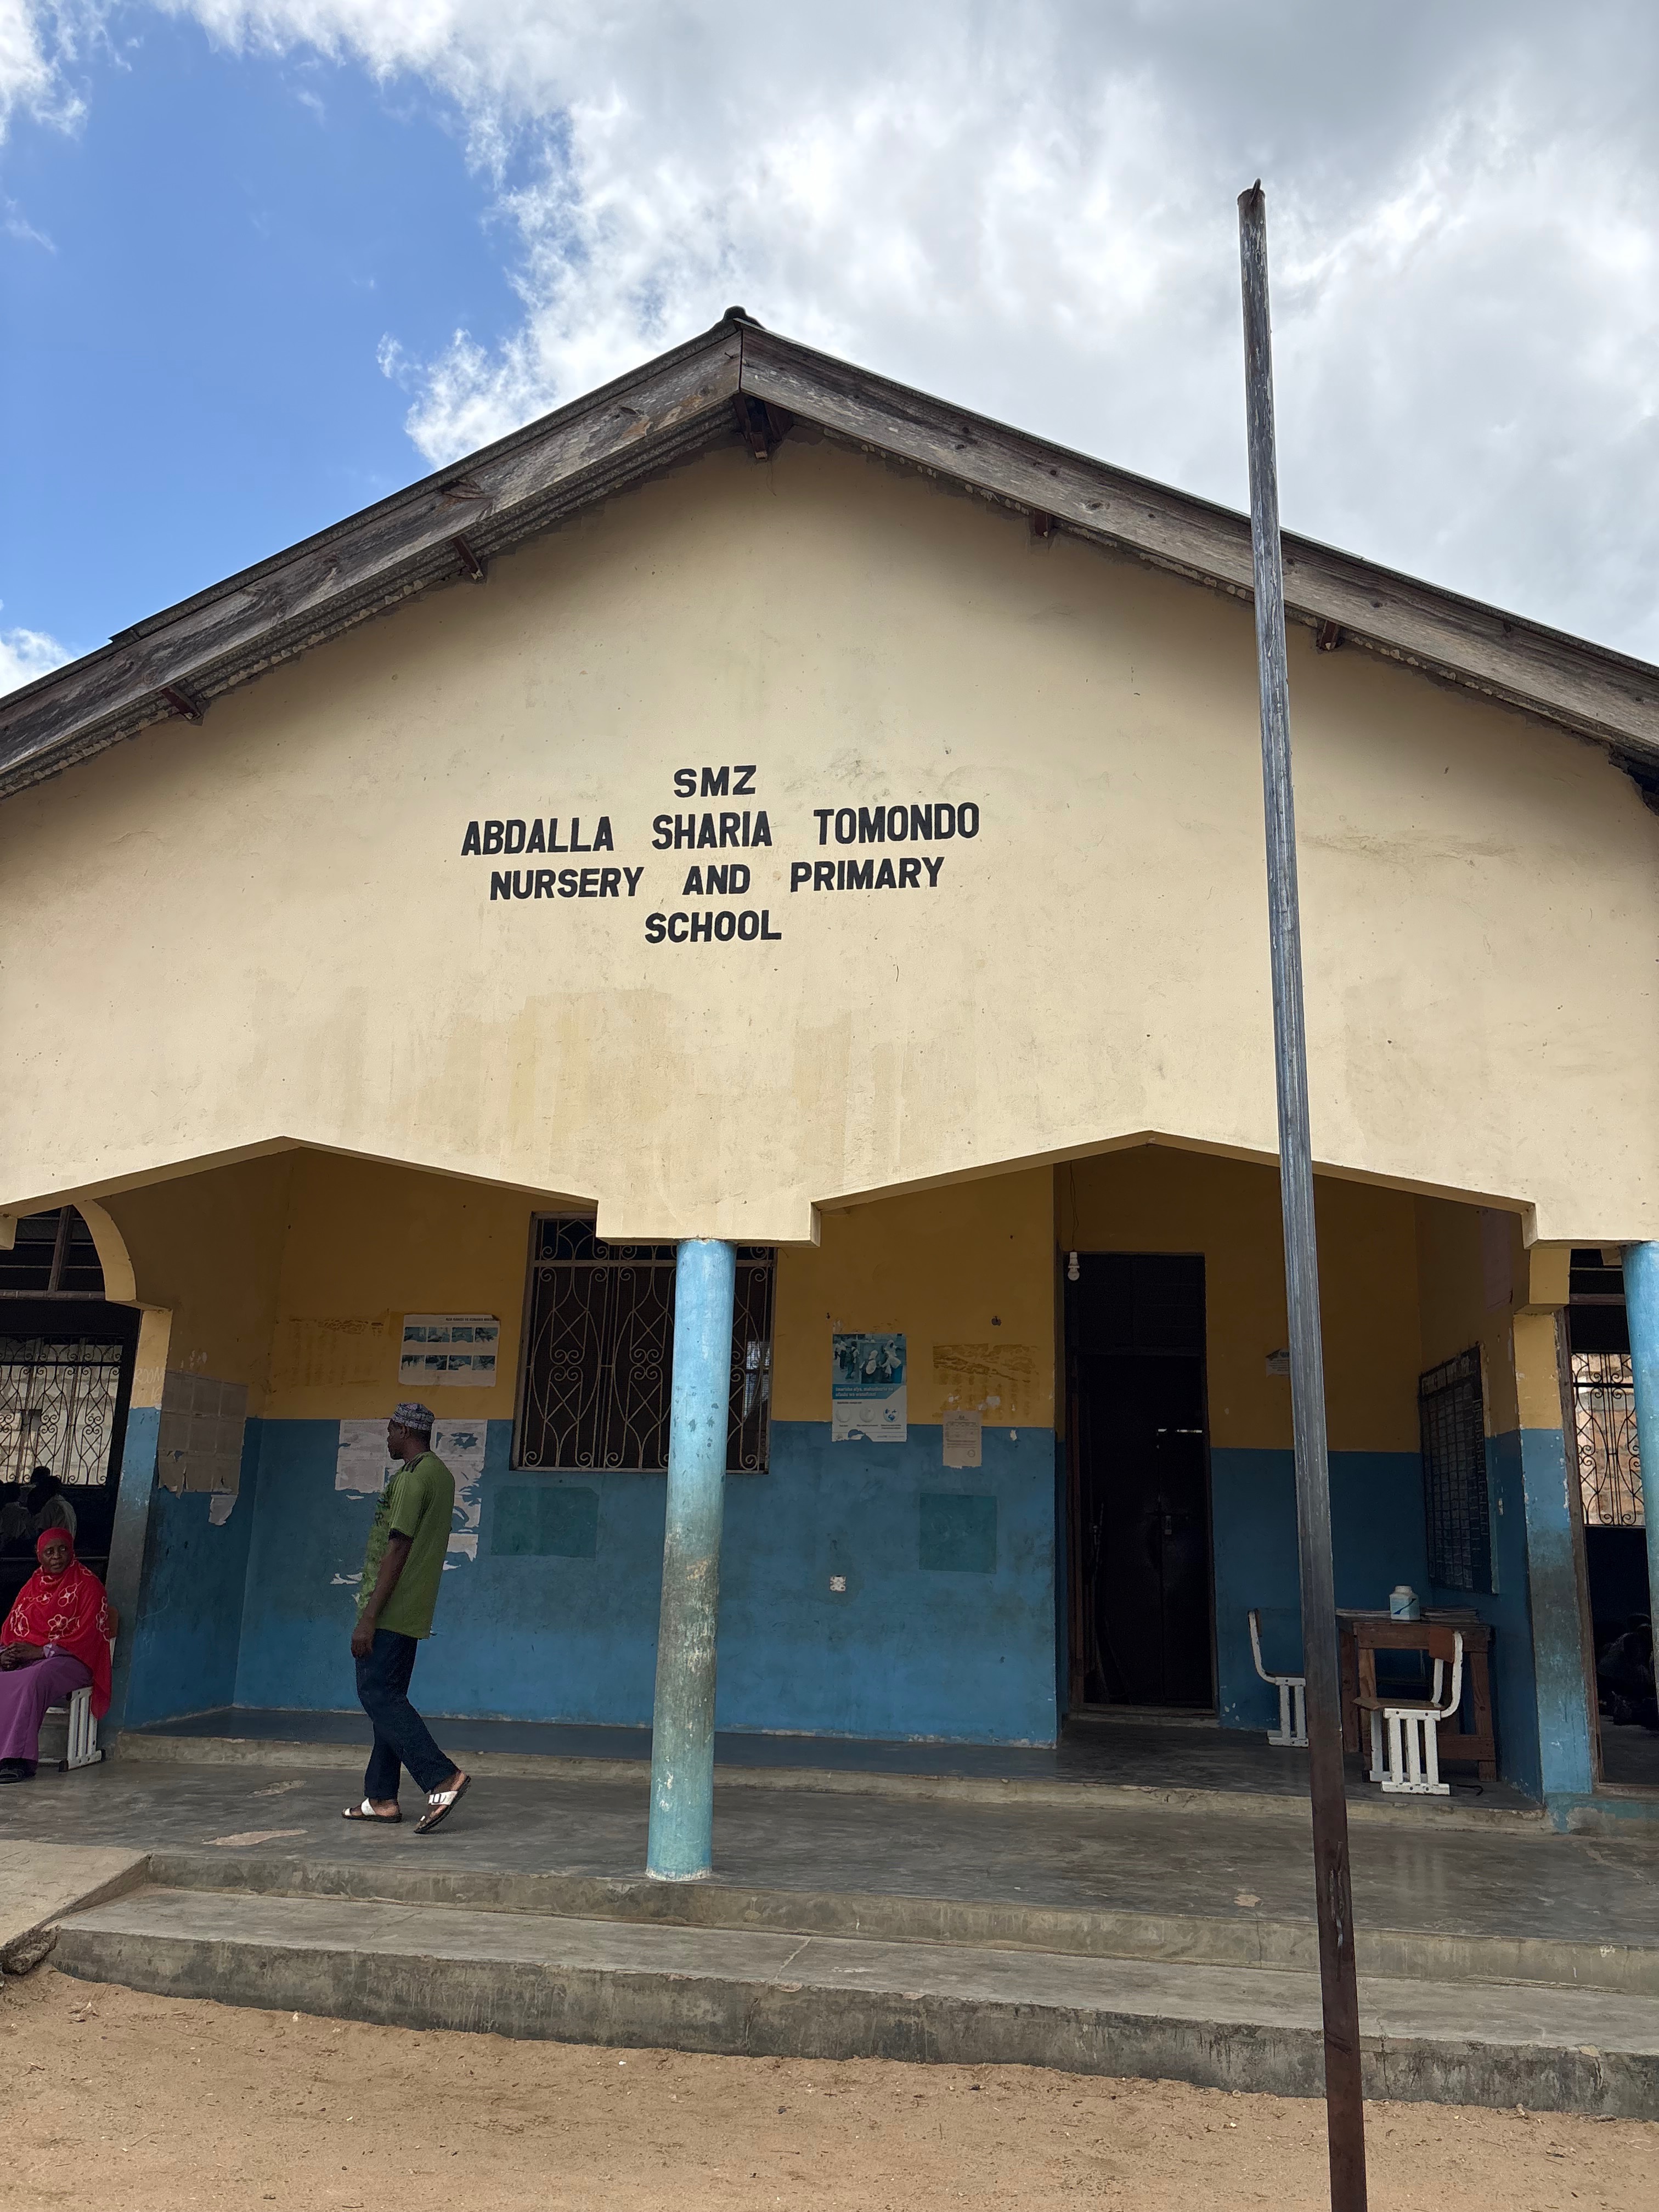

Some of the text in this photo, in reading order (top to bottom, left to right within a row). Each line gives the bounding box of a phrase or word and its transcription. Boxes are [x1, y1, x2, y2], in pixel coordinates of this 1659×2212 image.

[674, 765, 757, 798] SMZ
[460, 802, 980, 856] ABDALLA SHARIA TOMONDO
[490, 856, 945, 901] NURSERY AND PRIMARY
[645, 910, 782, 944] SCHOOL
